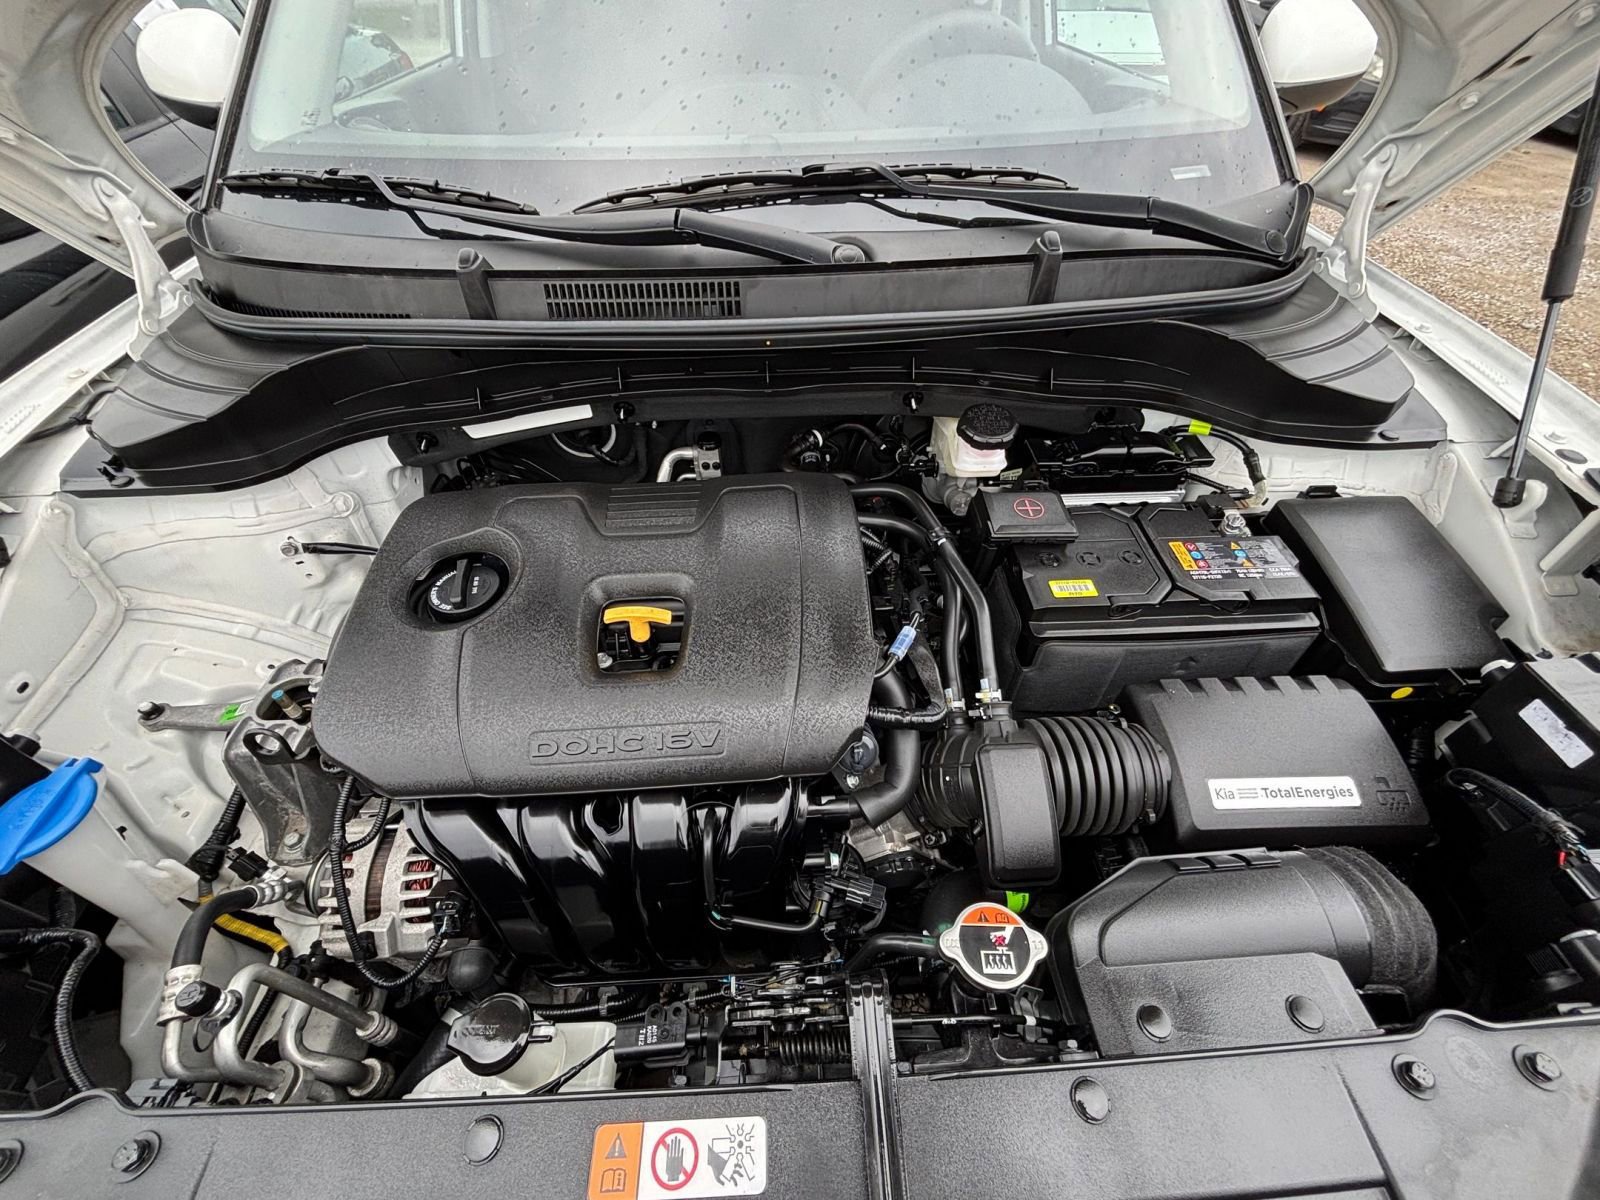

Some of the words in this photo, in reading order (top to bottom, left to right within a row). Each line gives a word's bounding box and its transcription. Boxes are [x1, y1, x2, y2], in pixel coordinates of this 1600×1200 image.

[531, 734, 644, 758] DOHC
[657, 728, 721, 751] 16V
[1215, 788, 1236, 800] Kia
[1261, 785, 1354, 800] TotalEnergies
